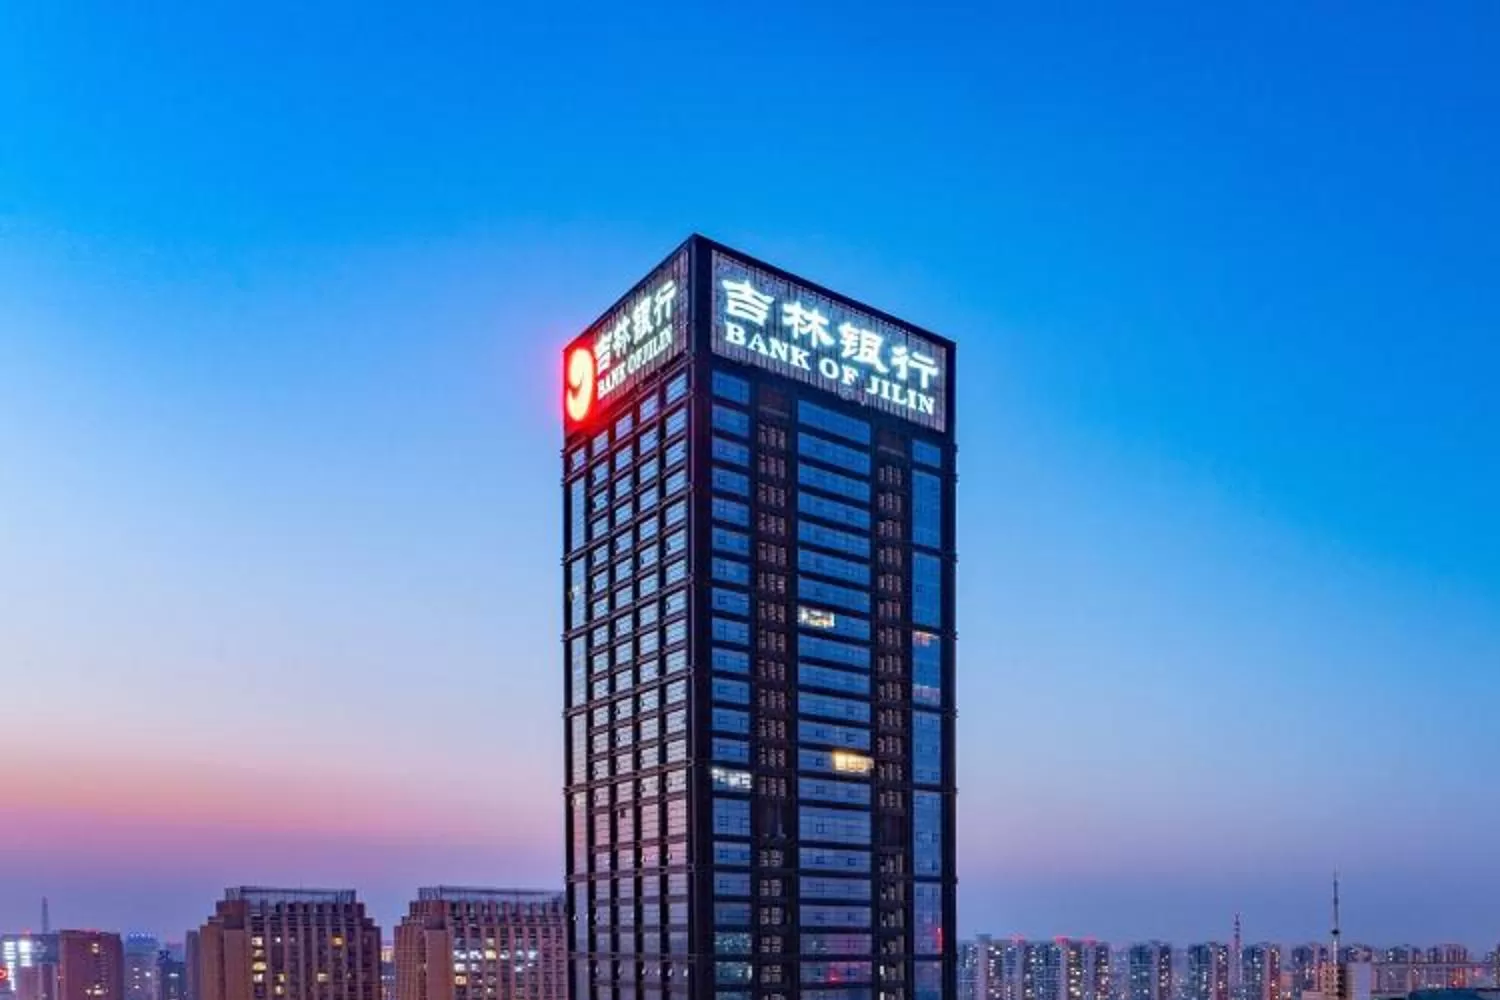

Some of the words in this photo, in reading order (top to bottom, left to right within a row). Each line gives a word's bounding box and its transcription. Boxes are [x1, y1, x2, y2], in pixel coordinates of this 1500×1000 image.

[721, 279, 939, 390] 吉林银行
[725, 321, 811, 371] BANK
[819, 357, 859, 385] OF
[866, 376, 935, 415] JILIN
